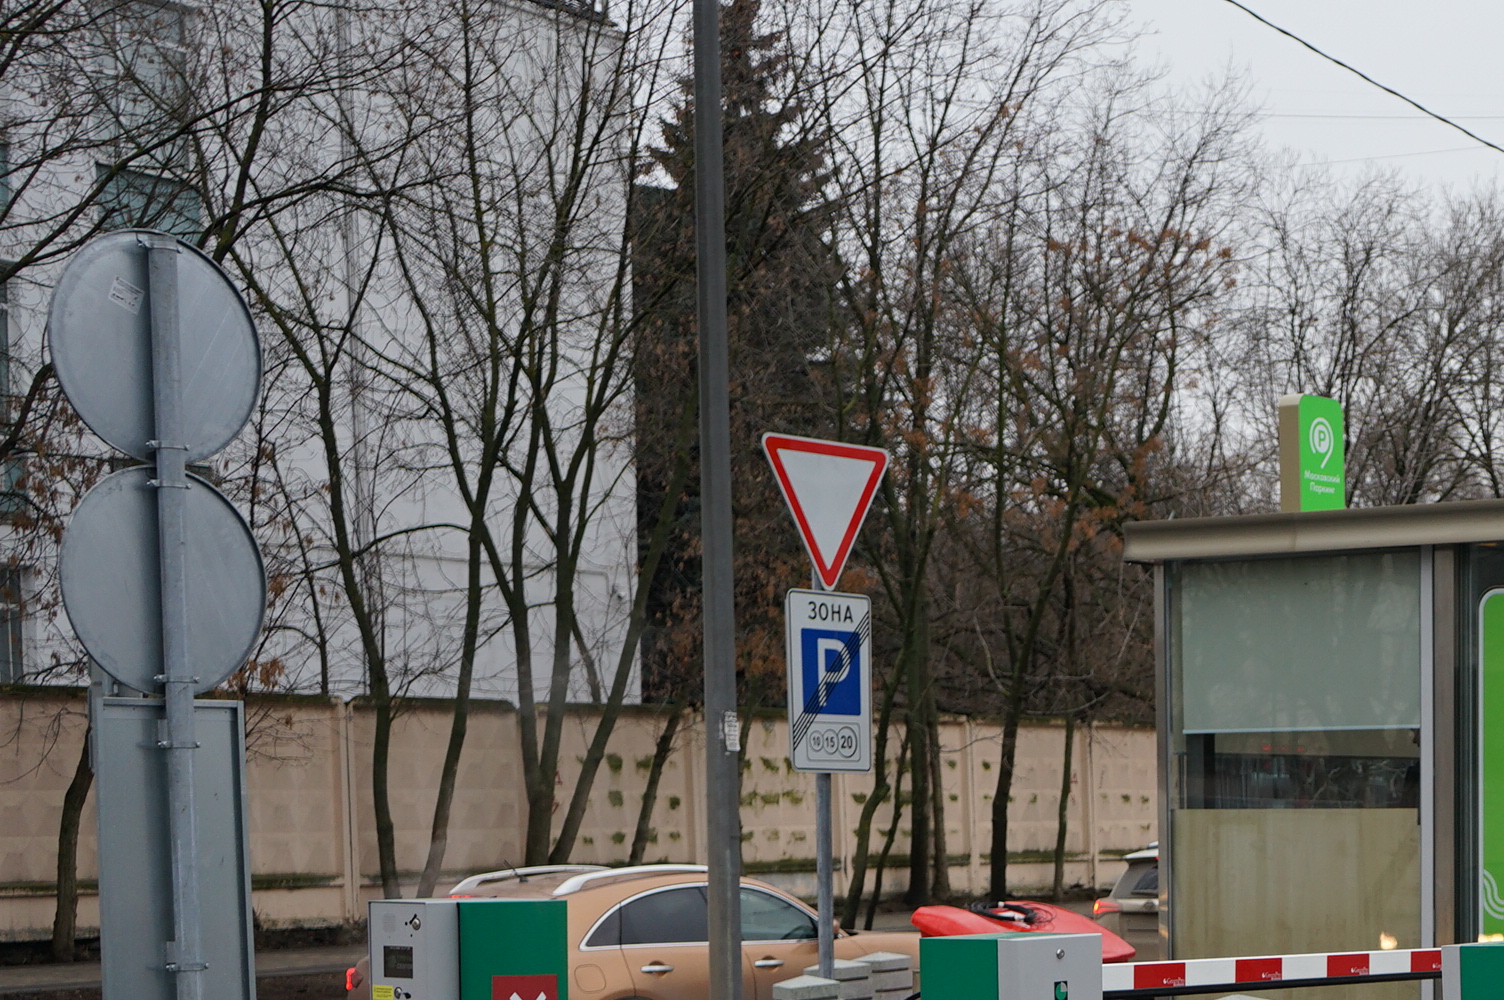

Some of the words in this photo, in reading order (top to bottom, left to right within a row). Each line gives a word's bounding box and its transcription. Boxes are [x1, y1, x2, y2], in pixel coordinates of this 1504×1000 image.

[808, 601, 854, 623] ЗОНА
[812, 736, 821, 746] 10
[825, 736, 835, 745] 15
[840, 735, 853, 749] 20
